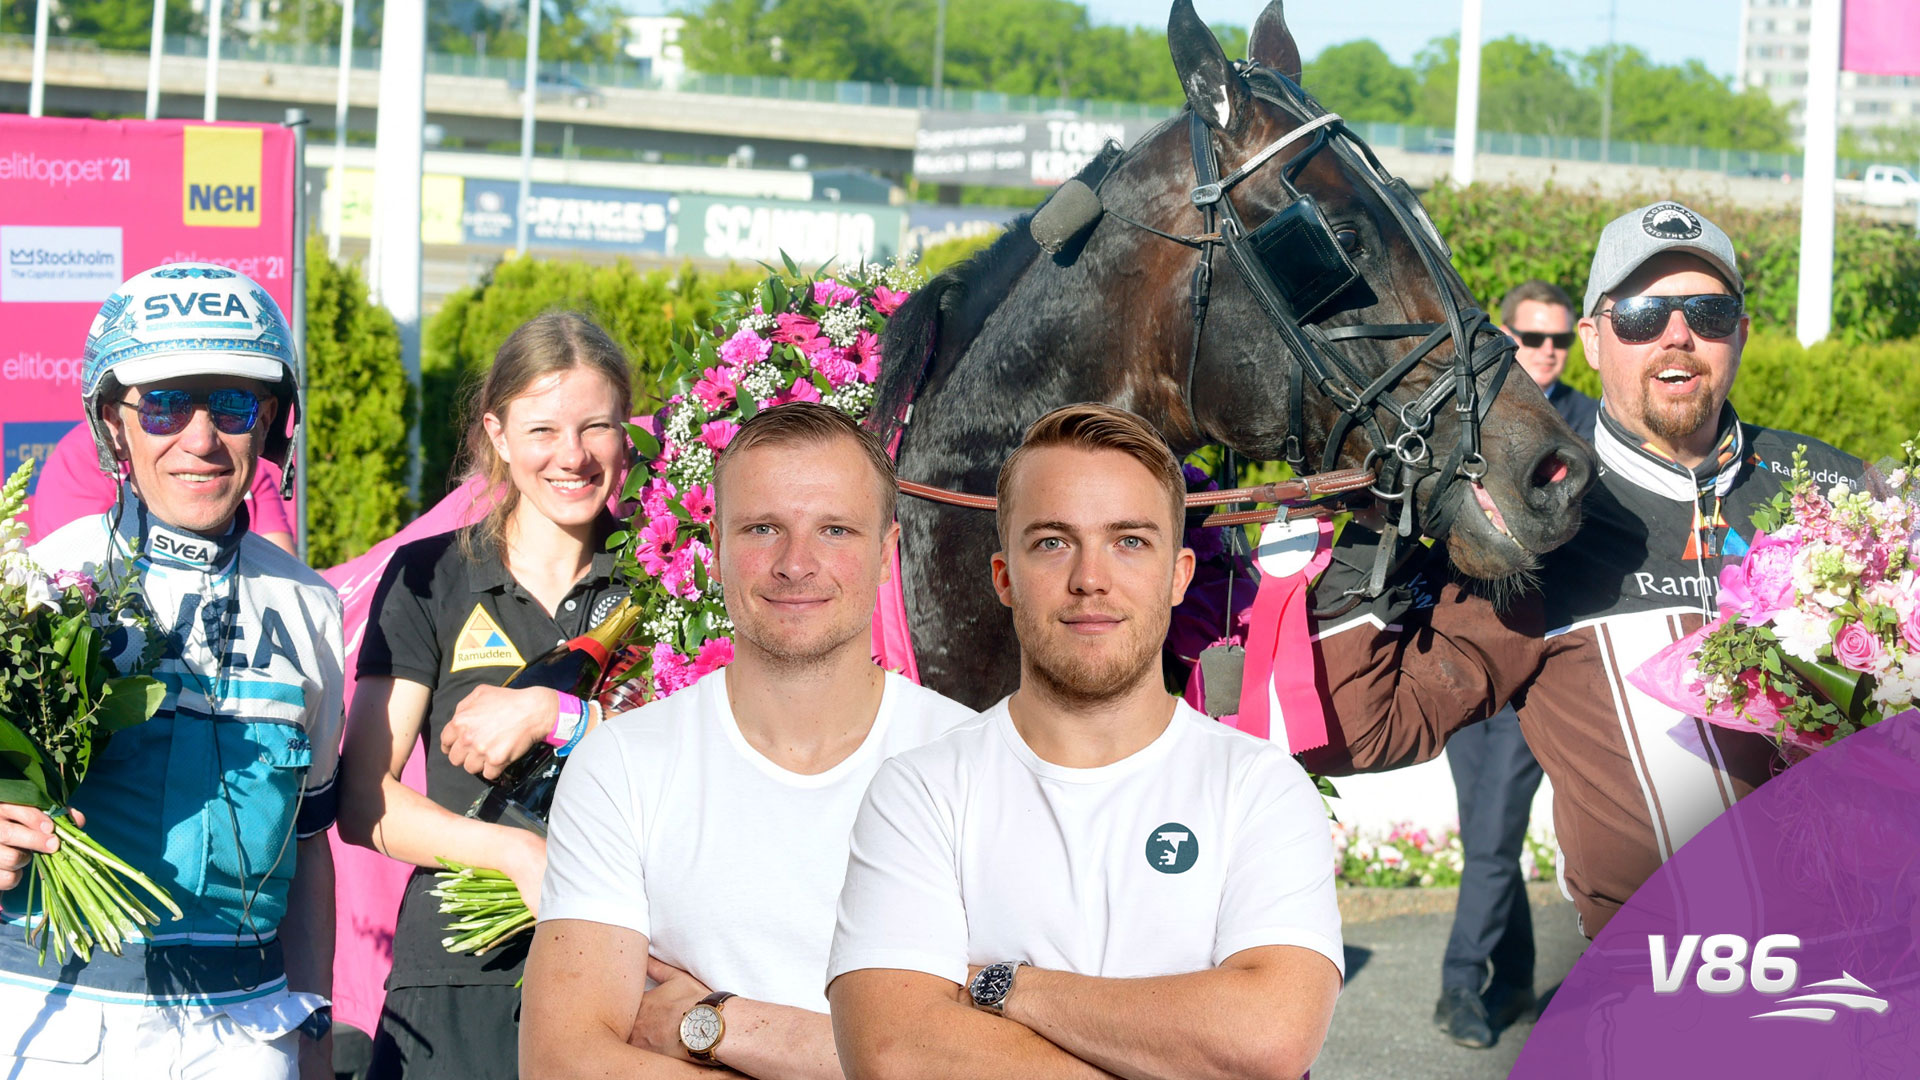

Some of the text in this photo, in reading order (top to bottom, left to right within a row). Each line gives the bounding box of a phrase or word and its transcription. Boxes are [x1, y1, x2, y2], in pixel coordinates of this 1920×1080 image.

[36, 248, 115, 265] Stockholm
[144, 292, 250, 320] SVEA
[3, 352, 83, 387] elitlopp
[154, 534, 209, 561] SVEA
[457, 649, 512, 663] Ramudden
